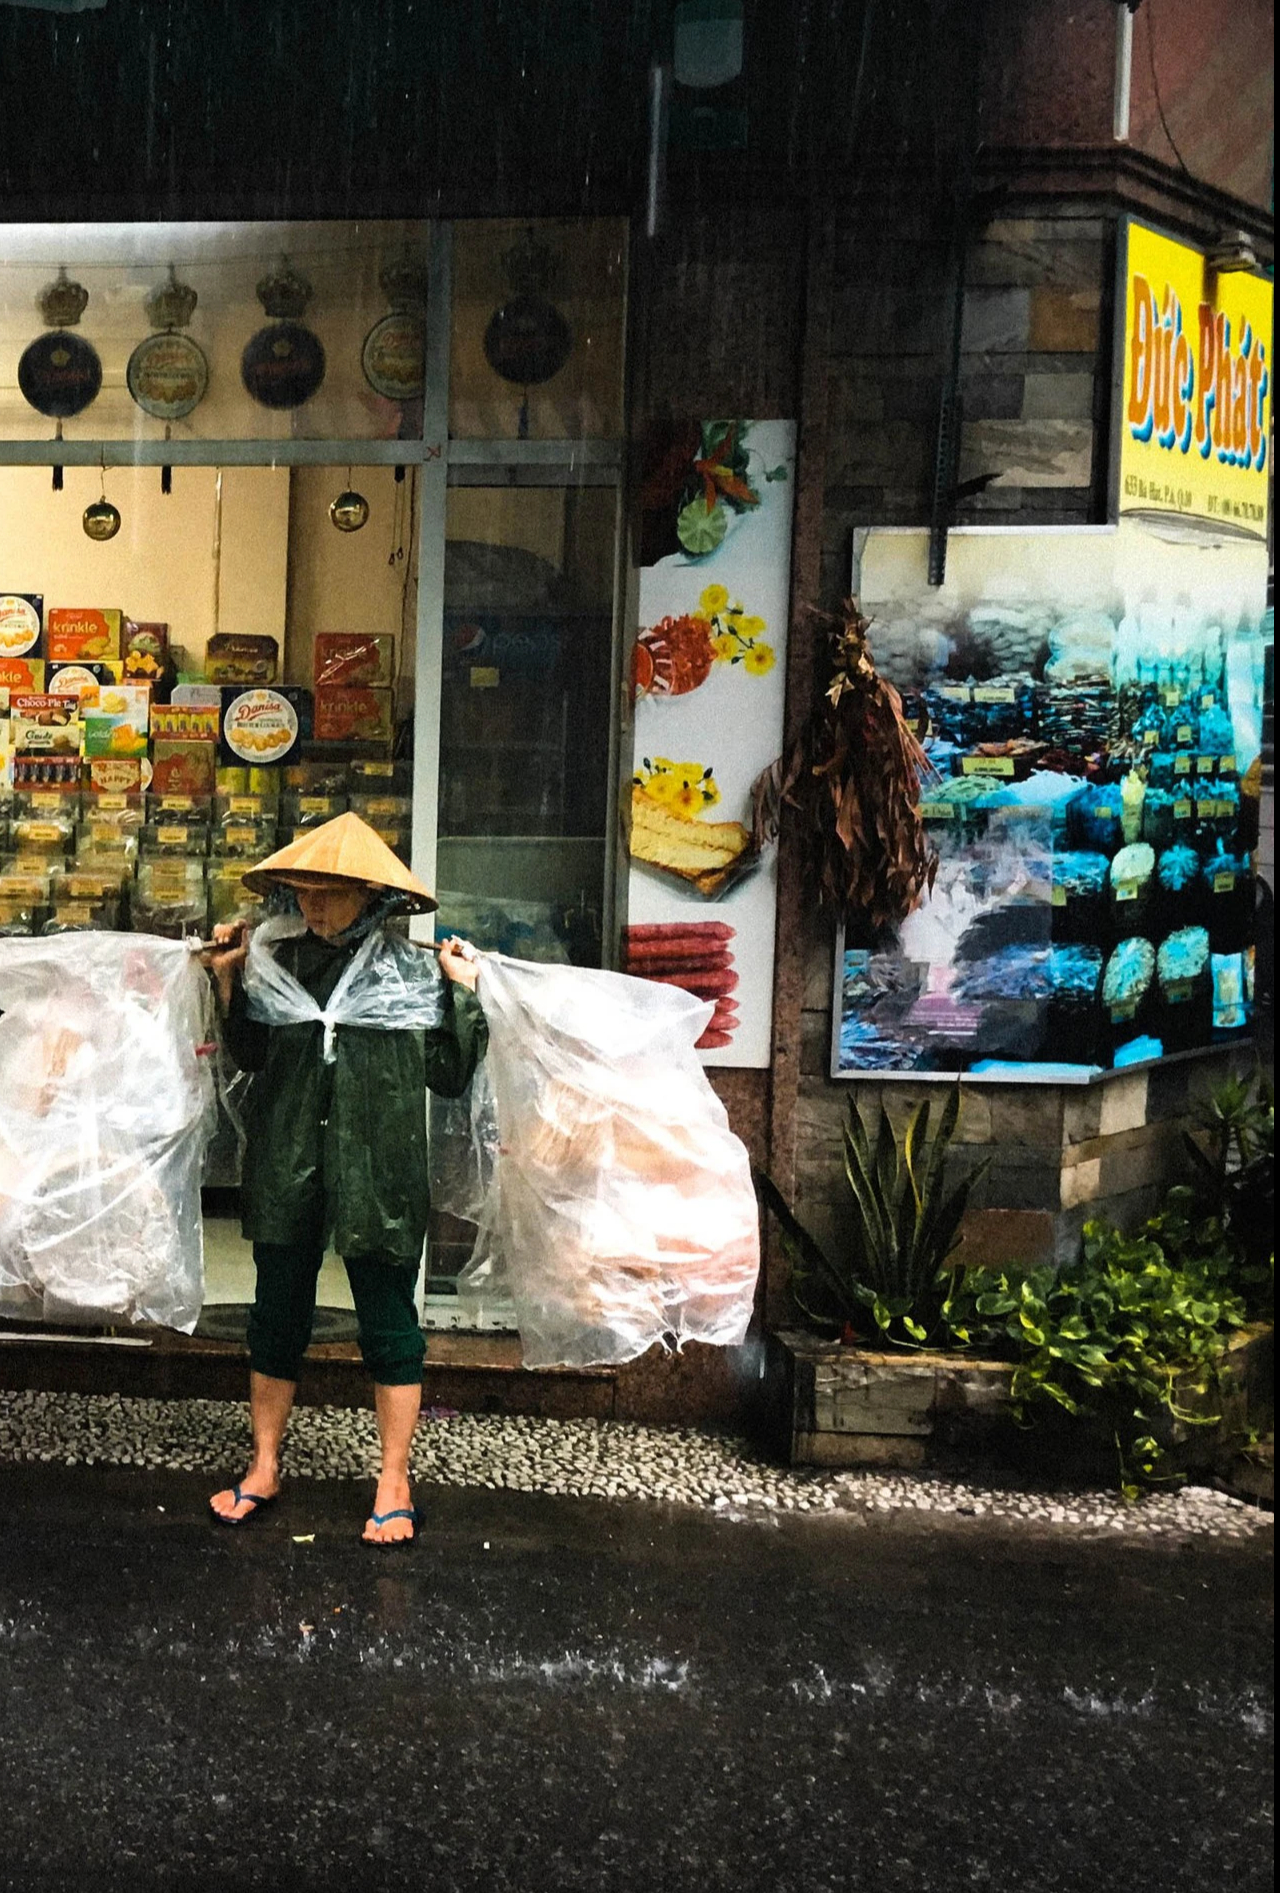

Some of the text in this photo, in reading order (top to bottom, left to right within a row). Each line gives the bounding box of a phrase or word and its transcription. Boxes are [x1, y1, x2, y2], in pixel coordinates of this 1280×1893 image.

[53, 621, 98, 634] krinkle
[17, 698, 47, 708] Choco
[234, 703, 283, 722] Danisa
